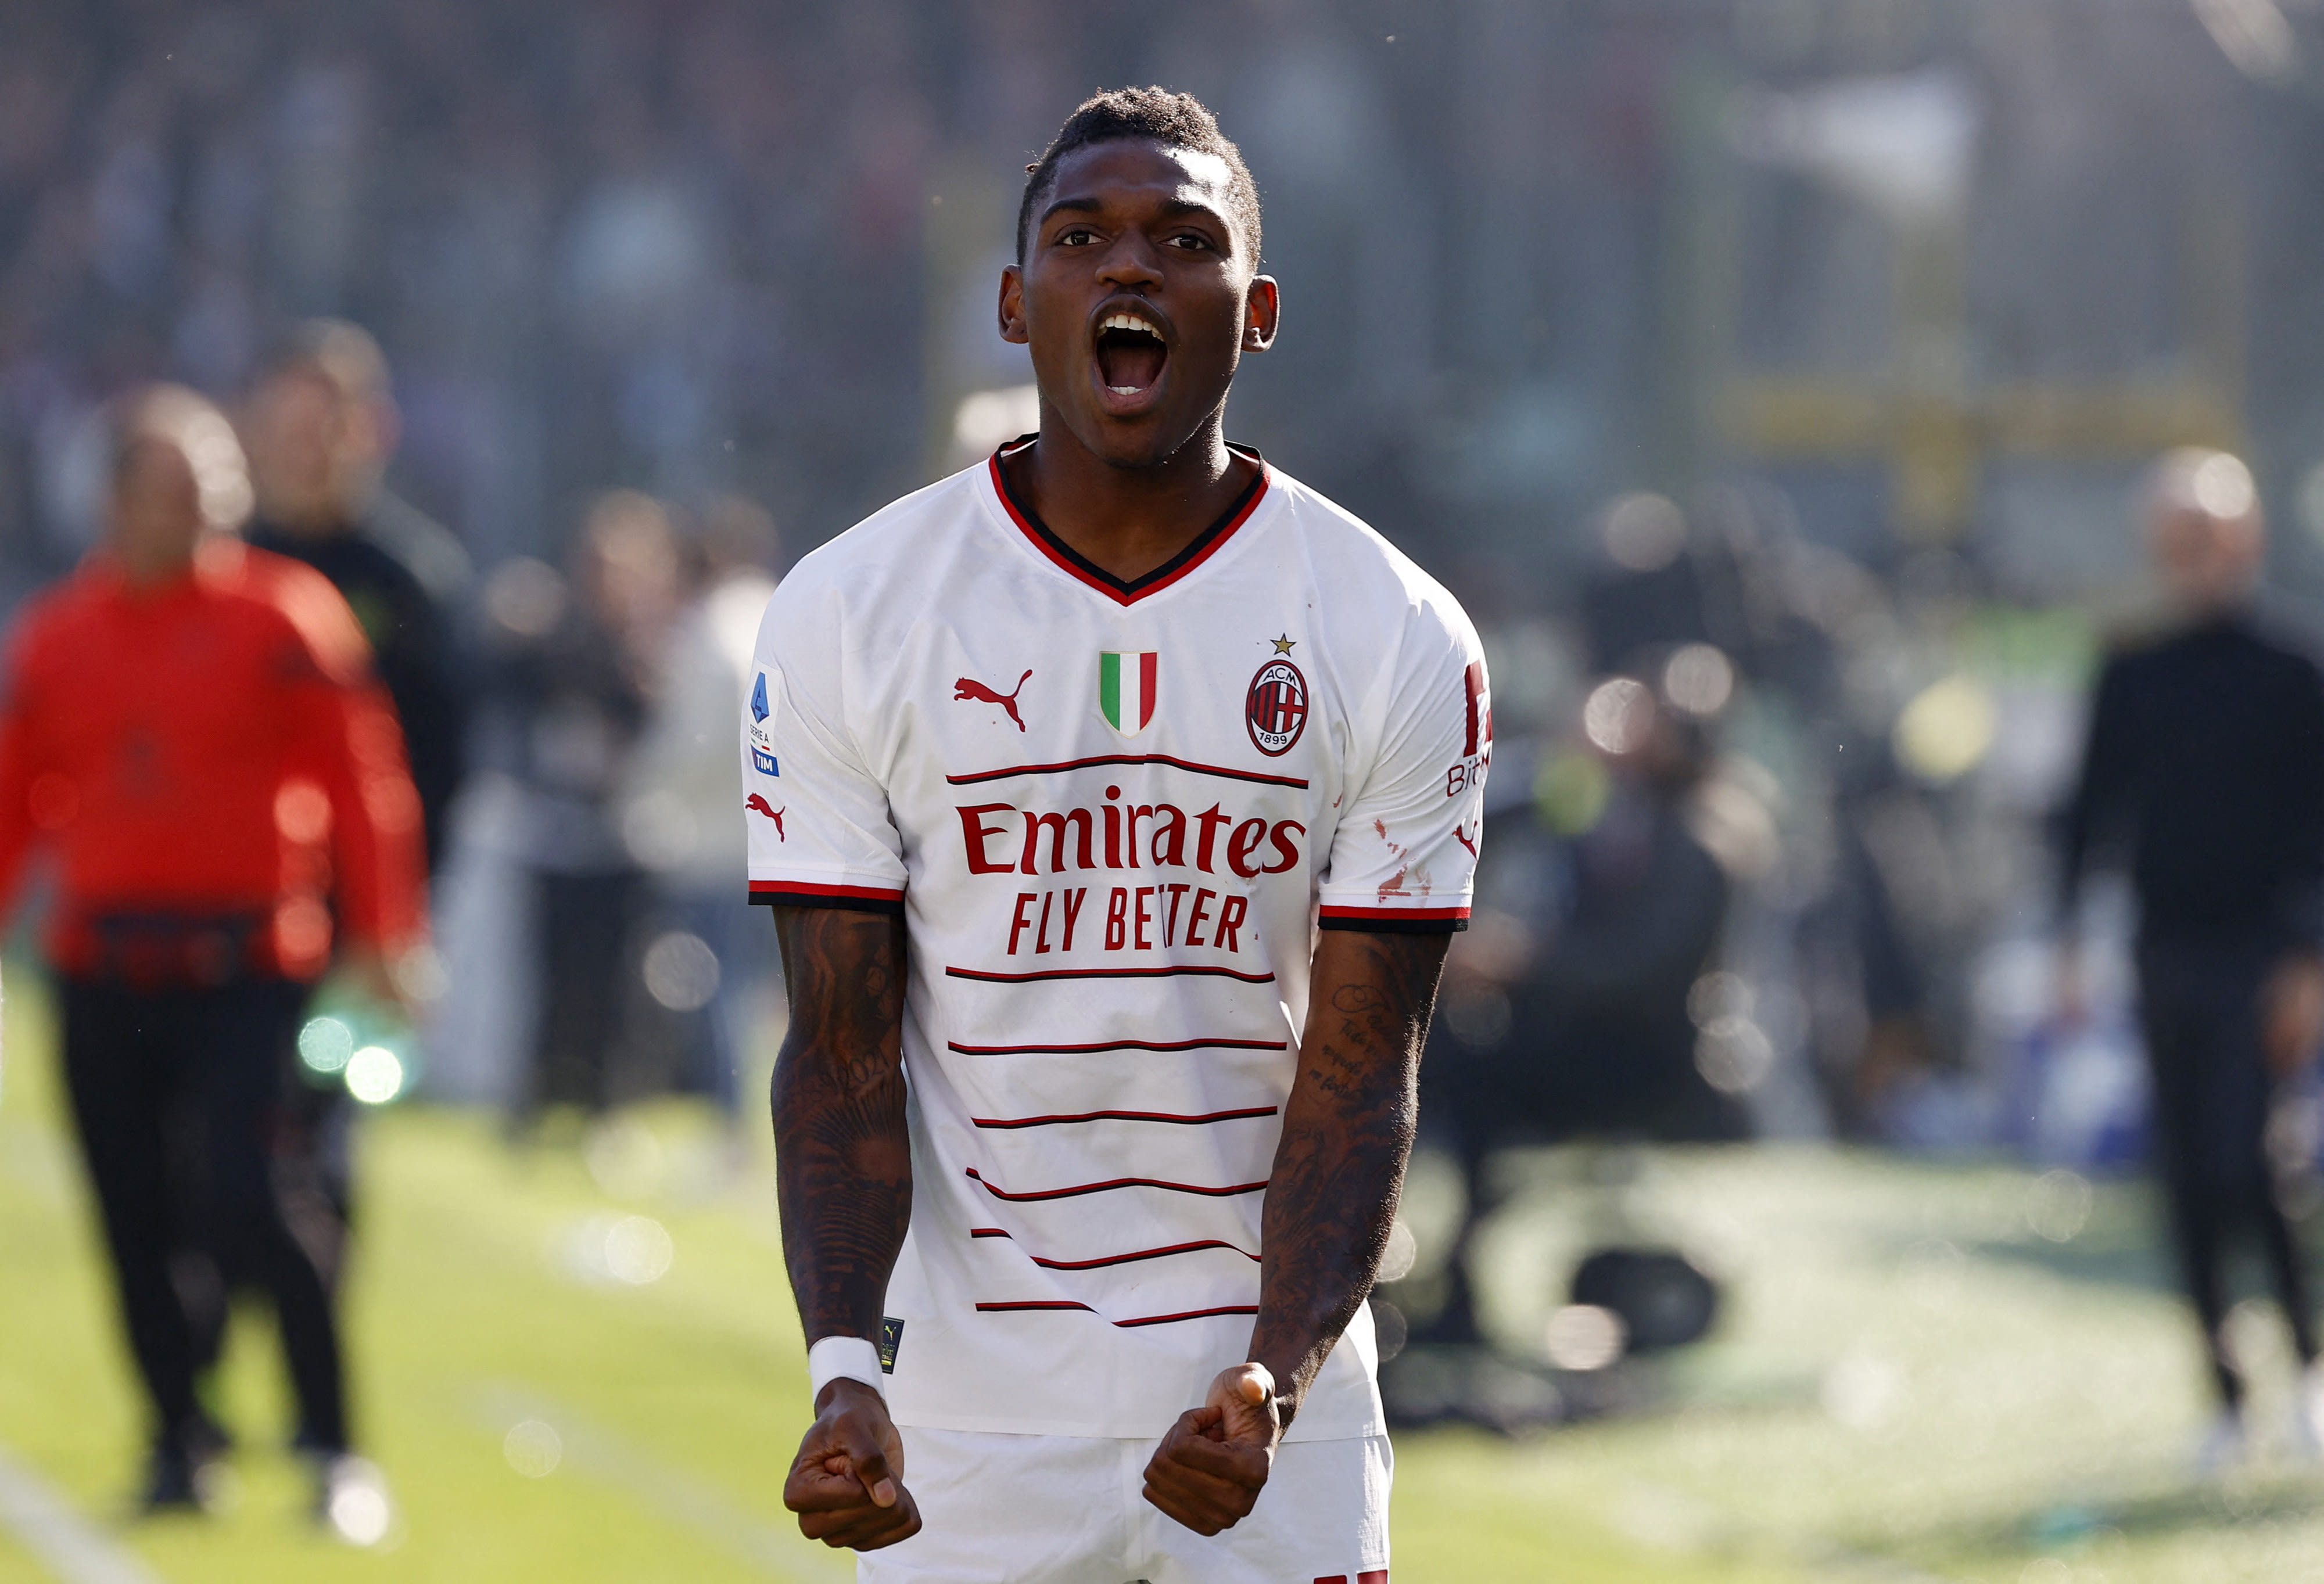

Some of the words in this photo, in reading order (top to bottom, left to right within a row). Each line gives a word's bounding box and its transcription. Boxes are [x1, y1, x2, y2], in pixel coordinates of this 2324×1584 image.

[1263, 667, 1296, 686] ACM
[750, 724, 763, 741] SERIE
[764, 732, 769, 743] A
[1259, 732, 1287, 745] 1899
[756, 753, 773, 772] TIM
[955, 785, 1307, 878] Emirates
[1007, 887, 1088, 956] FLY
[1104, 883, 1249, 954] BETER
